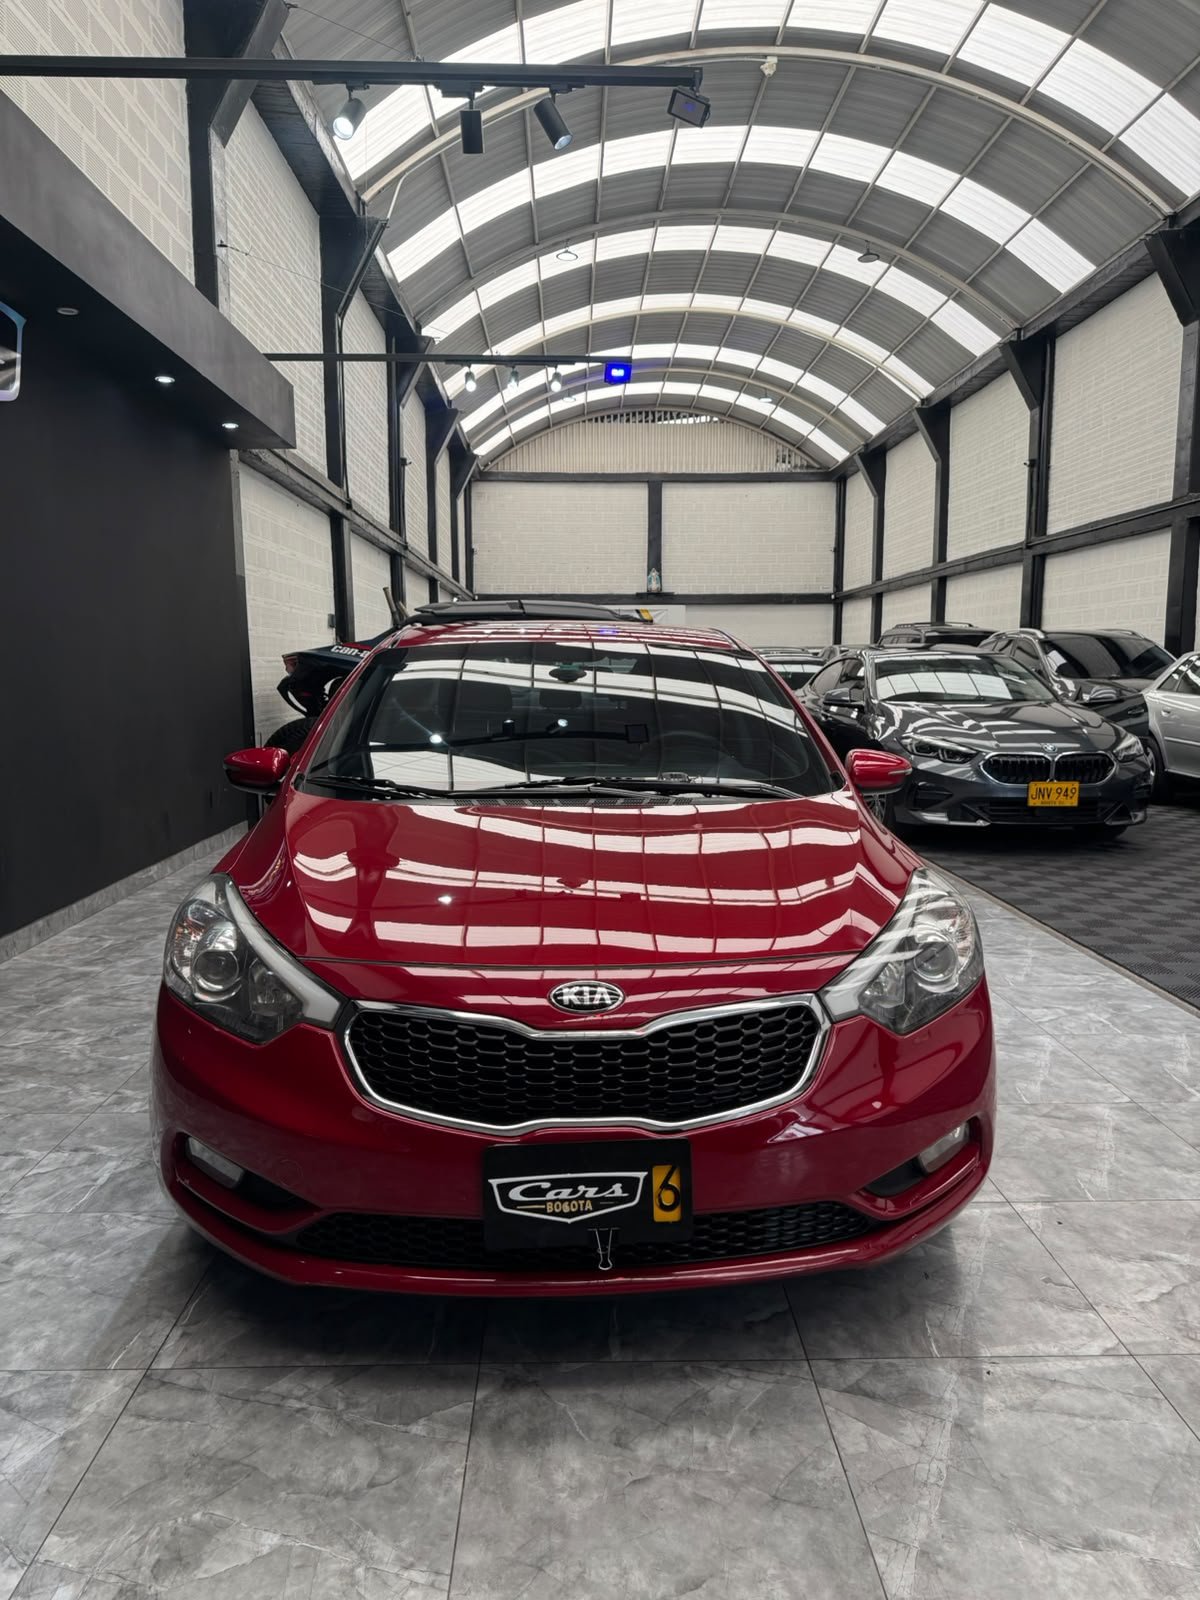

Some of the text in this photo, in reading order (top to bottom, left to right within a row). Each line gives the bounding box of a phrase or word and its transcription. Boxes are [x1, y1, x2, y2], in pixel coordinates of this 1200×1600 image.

[1031, 786, 1077, 800] JNV 949
[562, 986, 612, 1005] KIA
[508, 1181, 629, 1201] Cars
[657, 1165, 681, 1213] 6
[546, 1200, 593, 1213] BOGOTA
